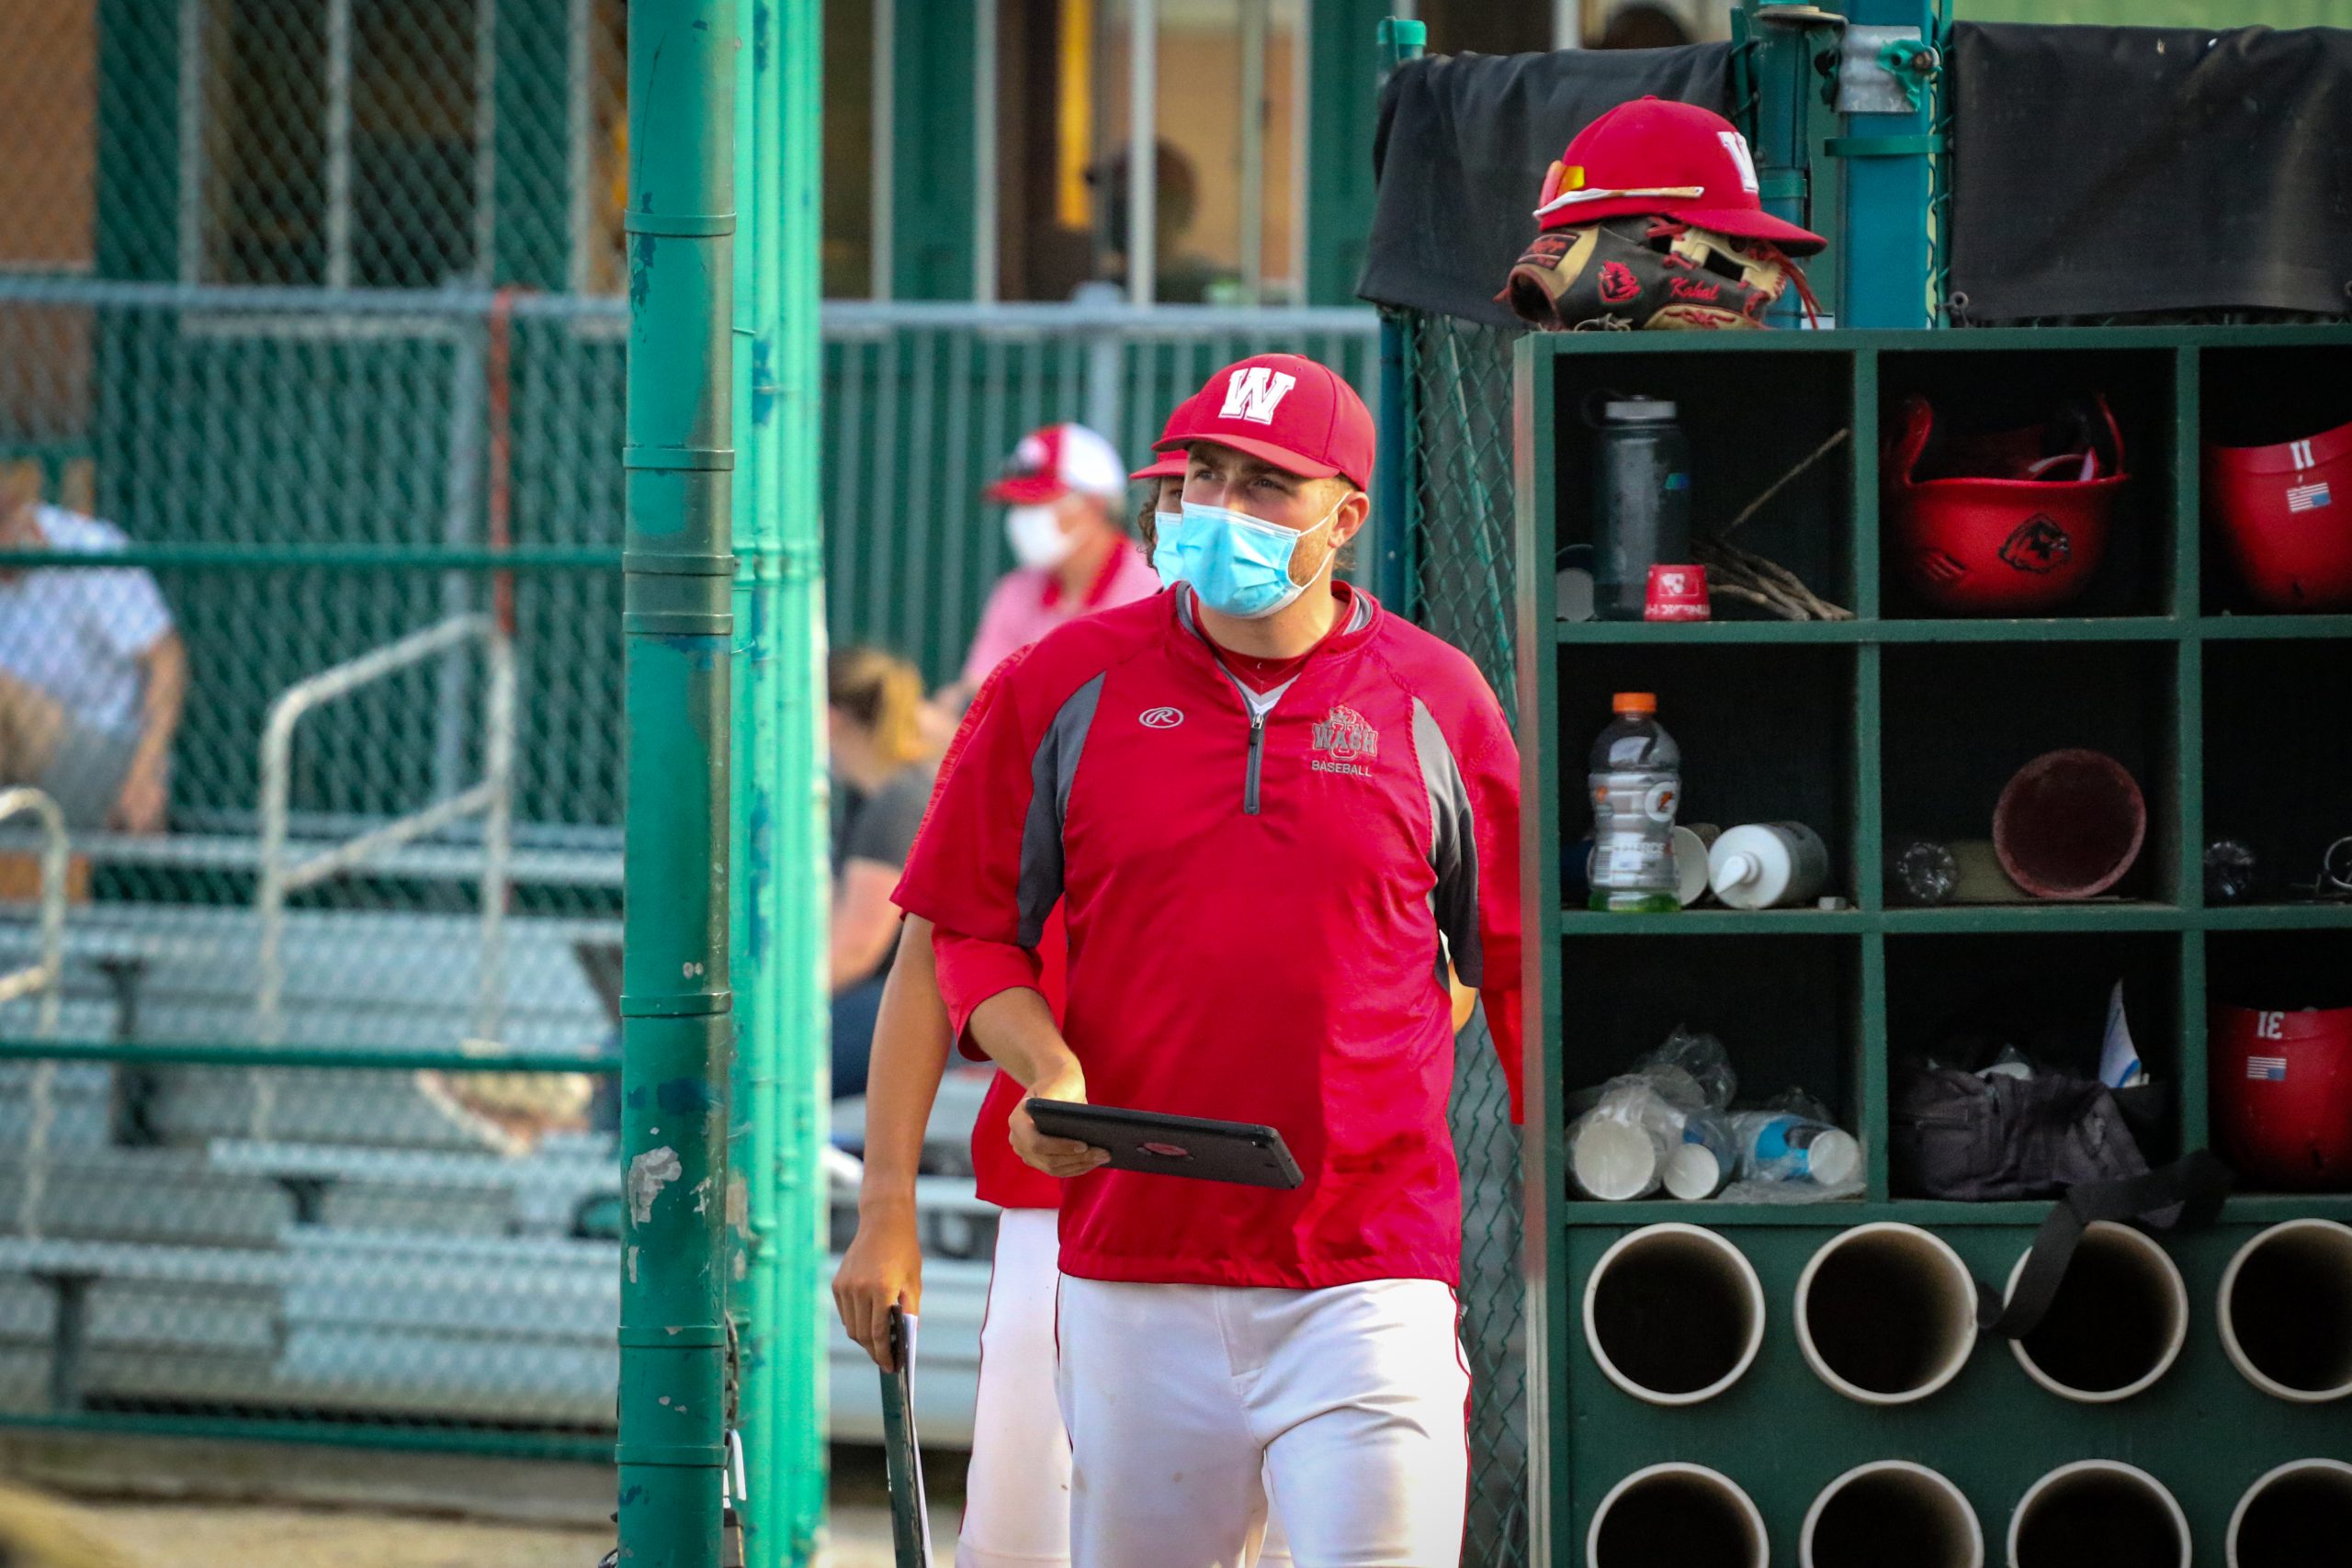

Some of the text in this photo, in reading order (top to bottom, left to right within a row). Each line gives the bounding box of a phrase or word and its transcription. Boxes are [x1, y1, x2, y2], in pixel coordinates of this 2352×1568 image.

[1217, 367, 1296, 426] W
[2290, 440, 2314, 469] 11
[1313, 724, 1376, 755] WASH
[1311, 760, 1373, 778] BASEBALL
[2257, 1011, 2284, 1039] 31
